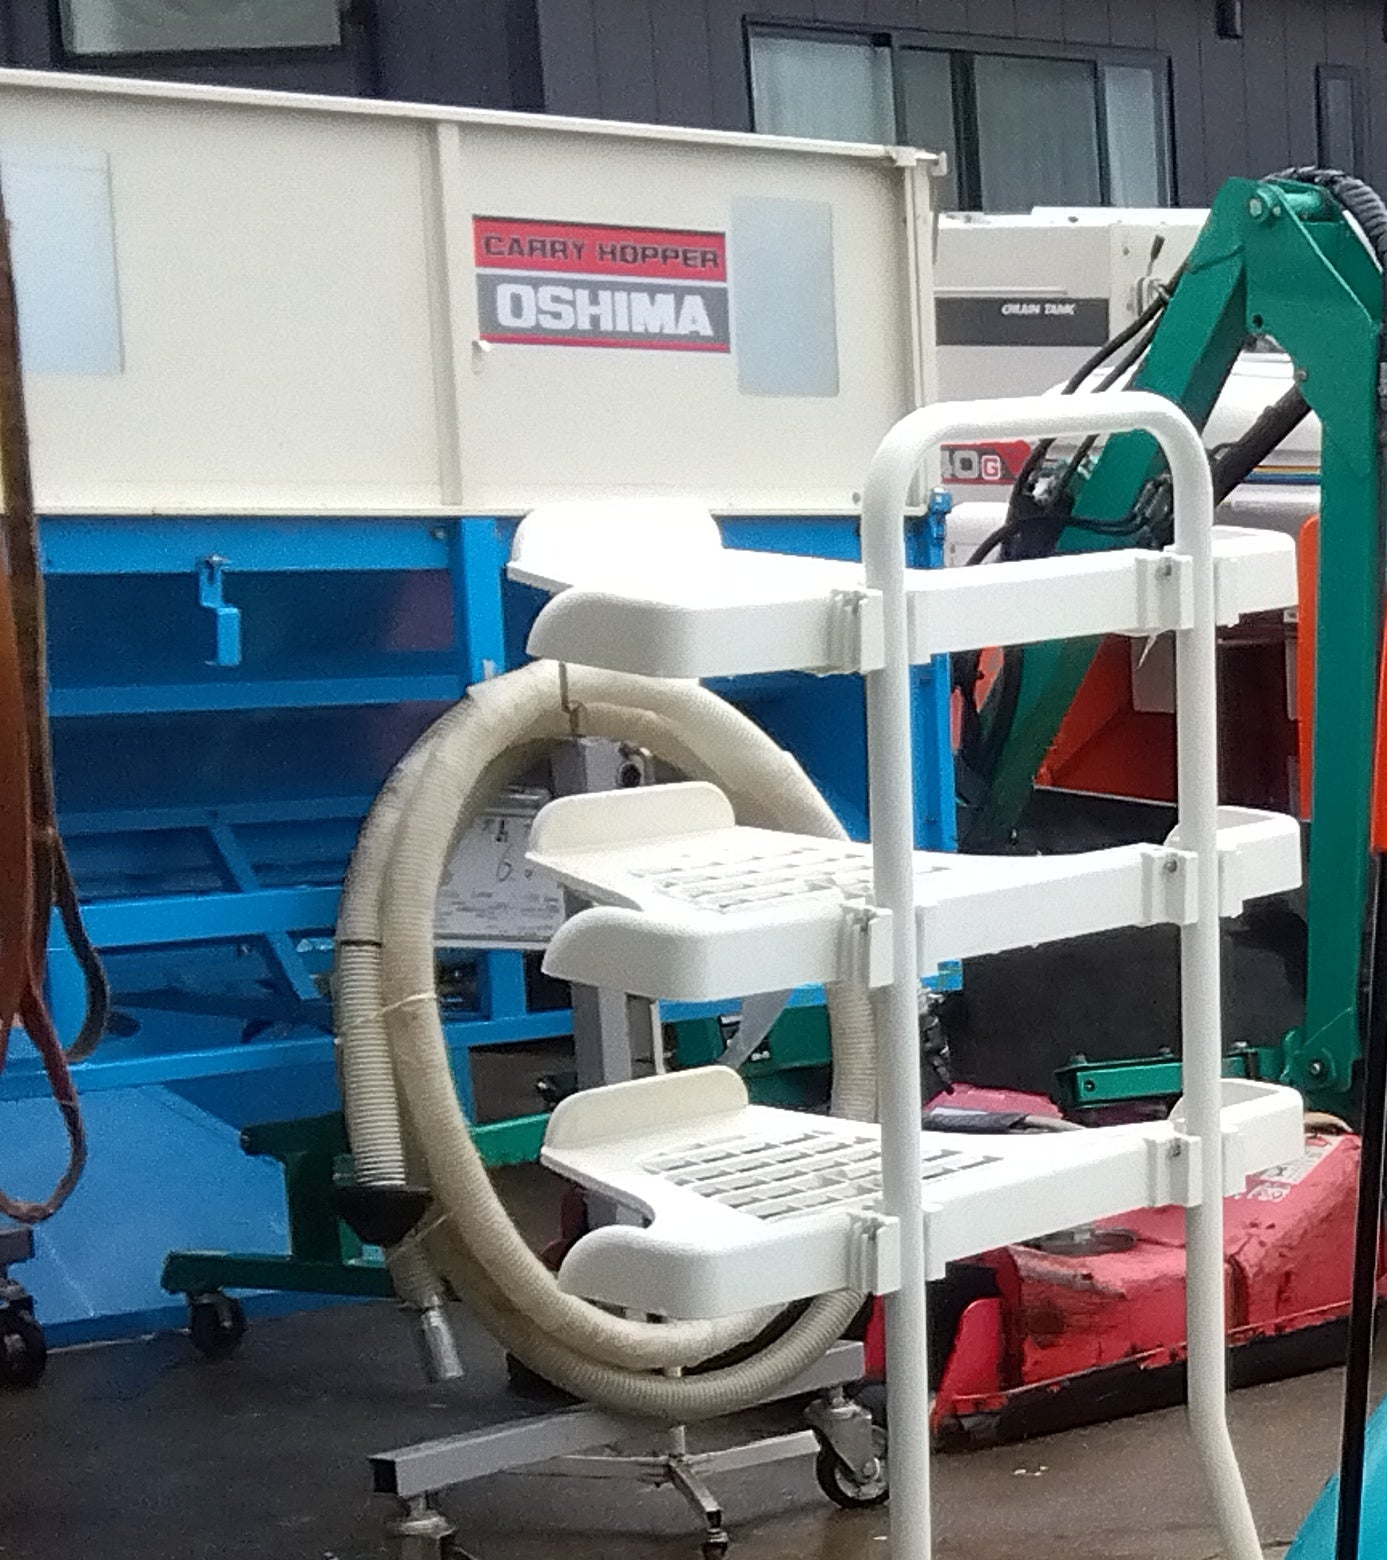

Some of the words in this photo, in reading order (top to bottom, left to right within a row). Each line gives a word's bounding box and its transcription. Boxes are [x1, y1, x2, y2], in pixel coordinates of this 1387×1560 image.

[483, 234, 585, 260] CARRY
[598, 241, 719, 268] HOPPER
[496, 283, 714, 336] OSHIMA
